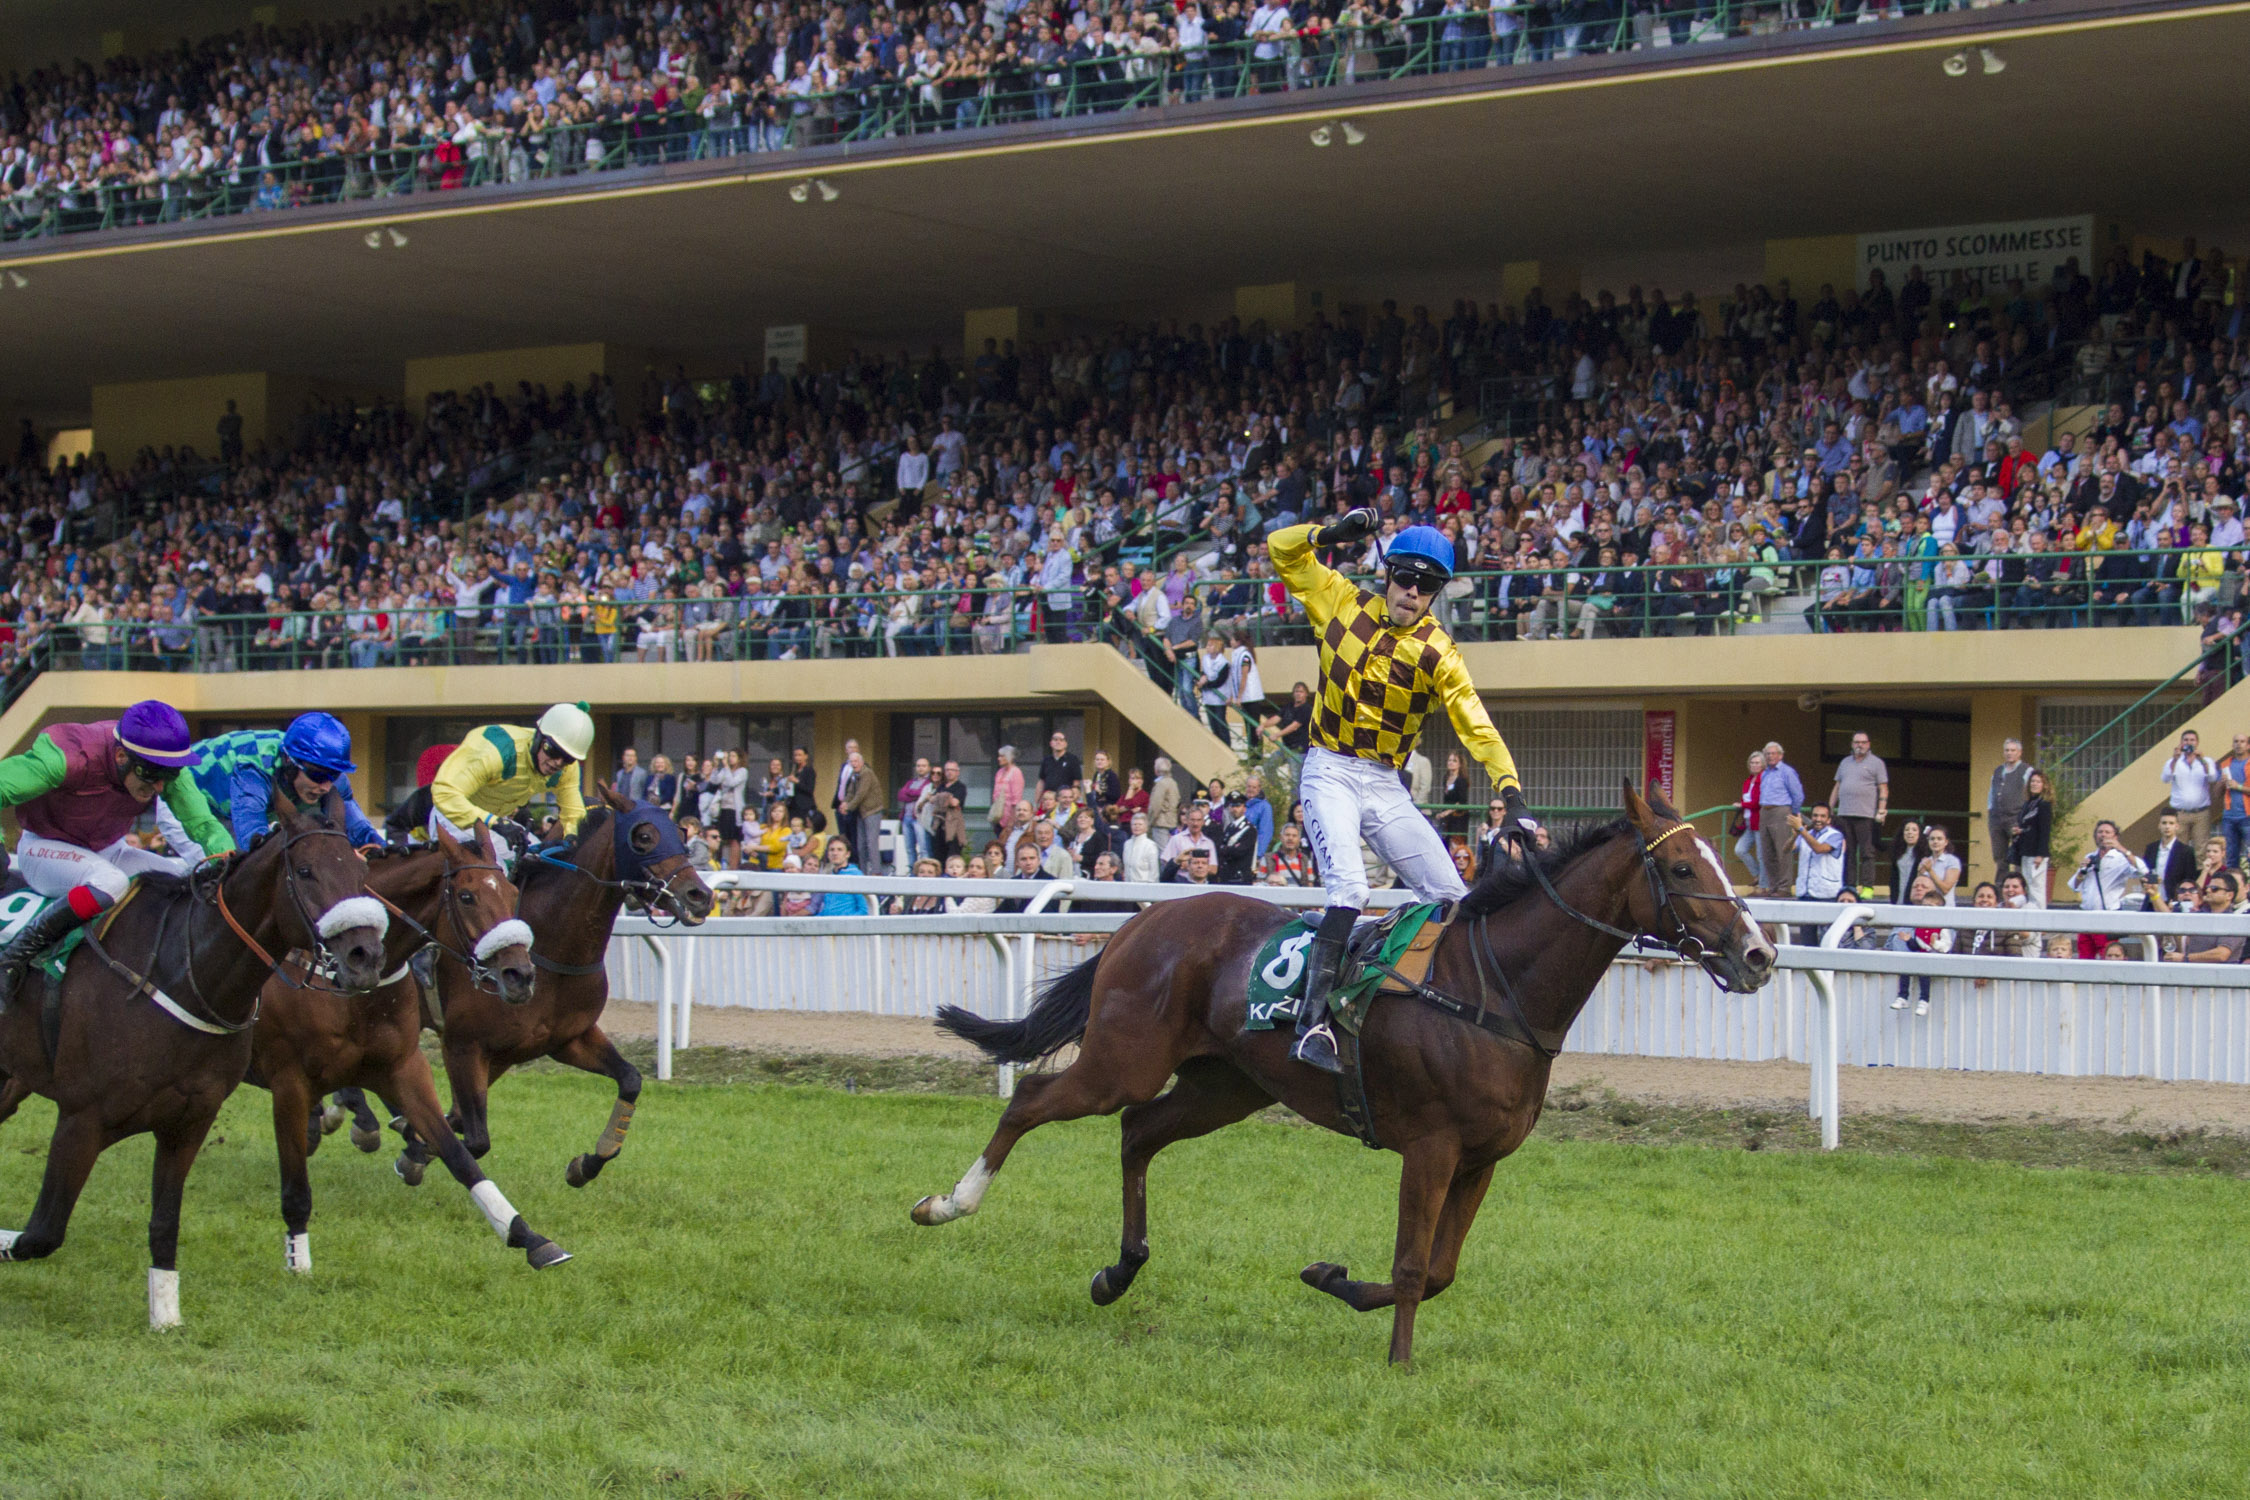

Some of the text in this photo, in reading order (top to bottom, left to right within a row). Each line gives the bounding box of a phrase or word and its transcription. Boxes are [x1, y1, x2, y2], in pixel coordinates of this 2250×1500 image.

[1867, 226, 2083, 264] PUNTO SCOMMESSE
[0, 891, 47, 944] 9
[1261, 930, 1316, 990] 8
